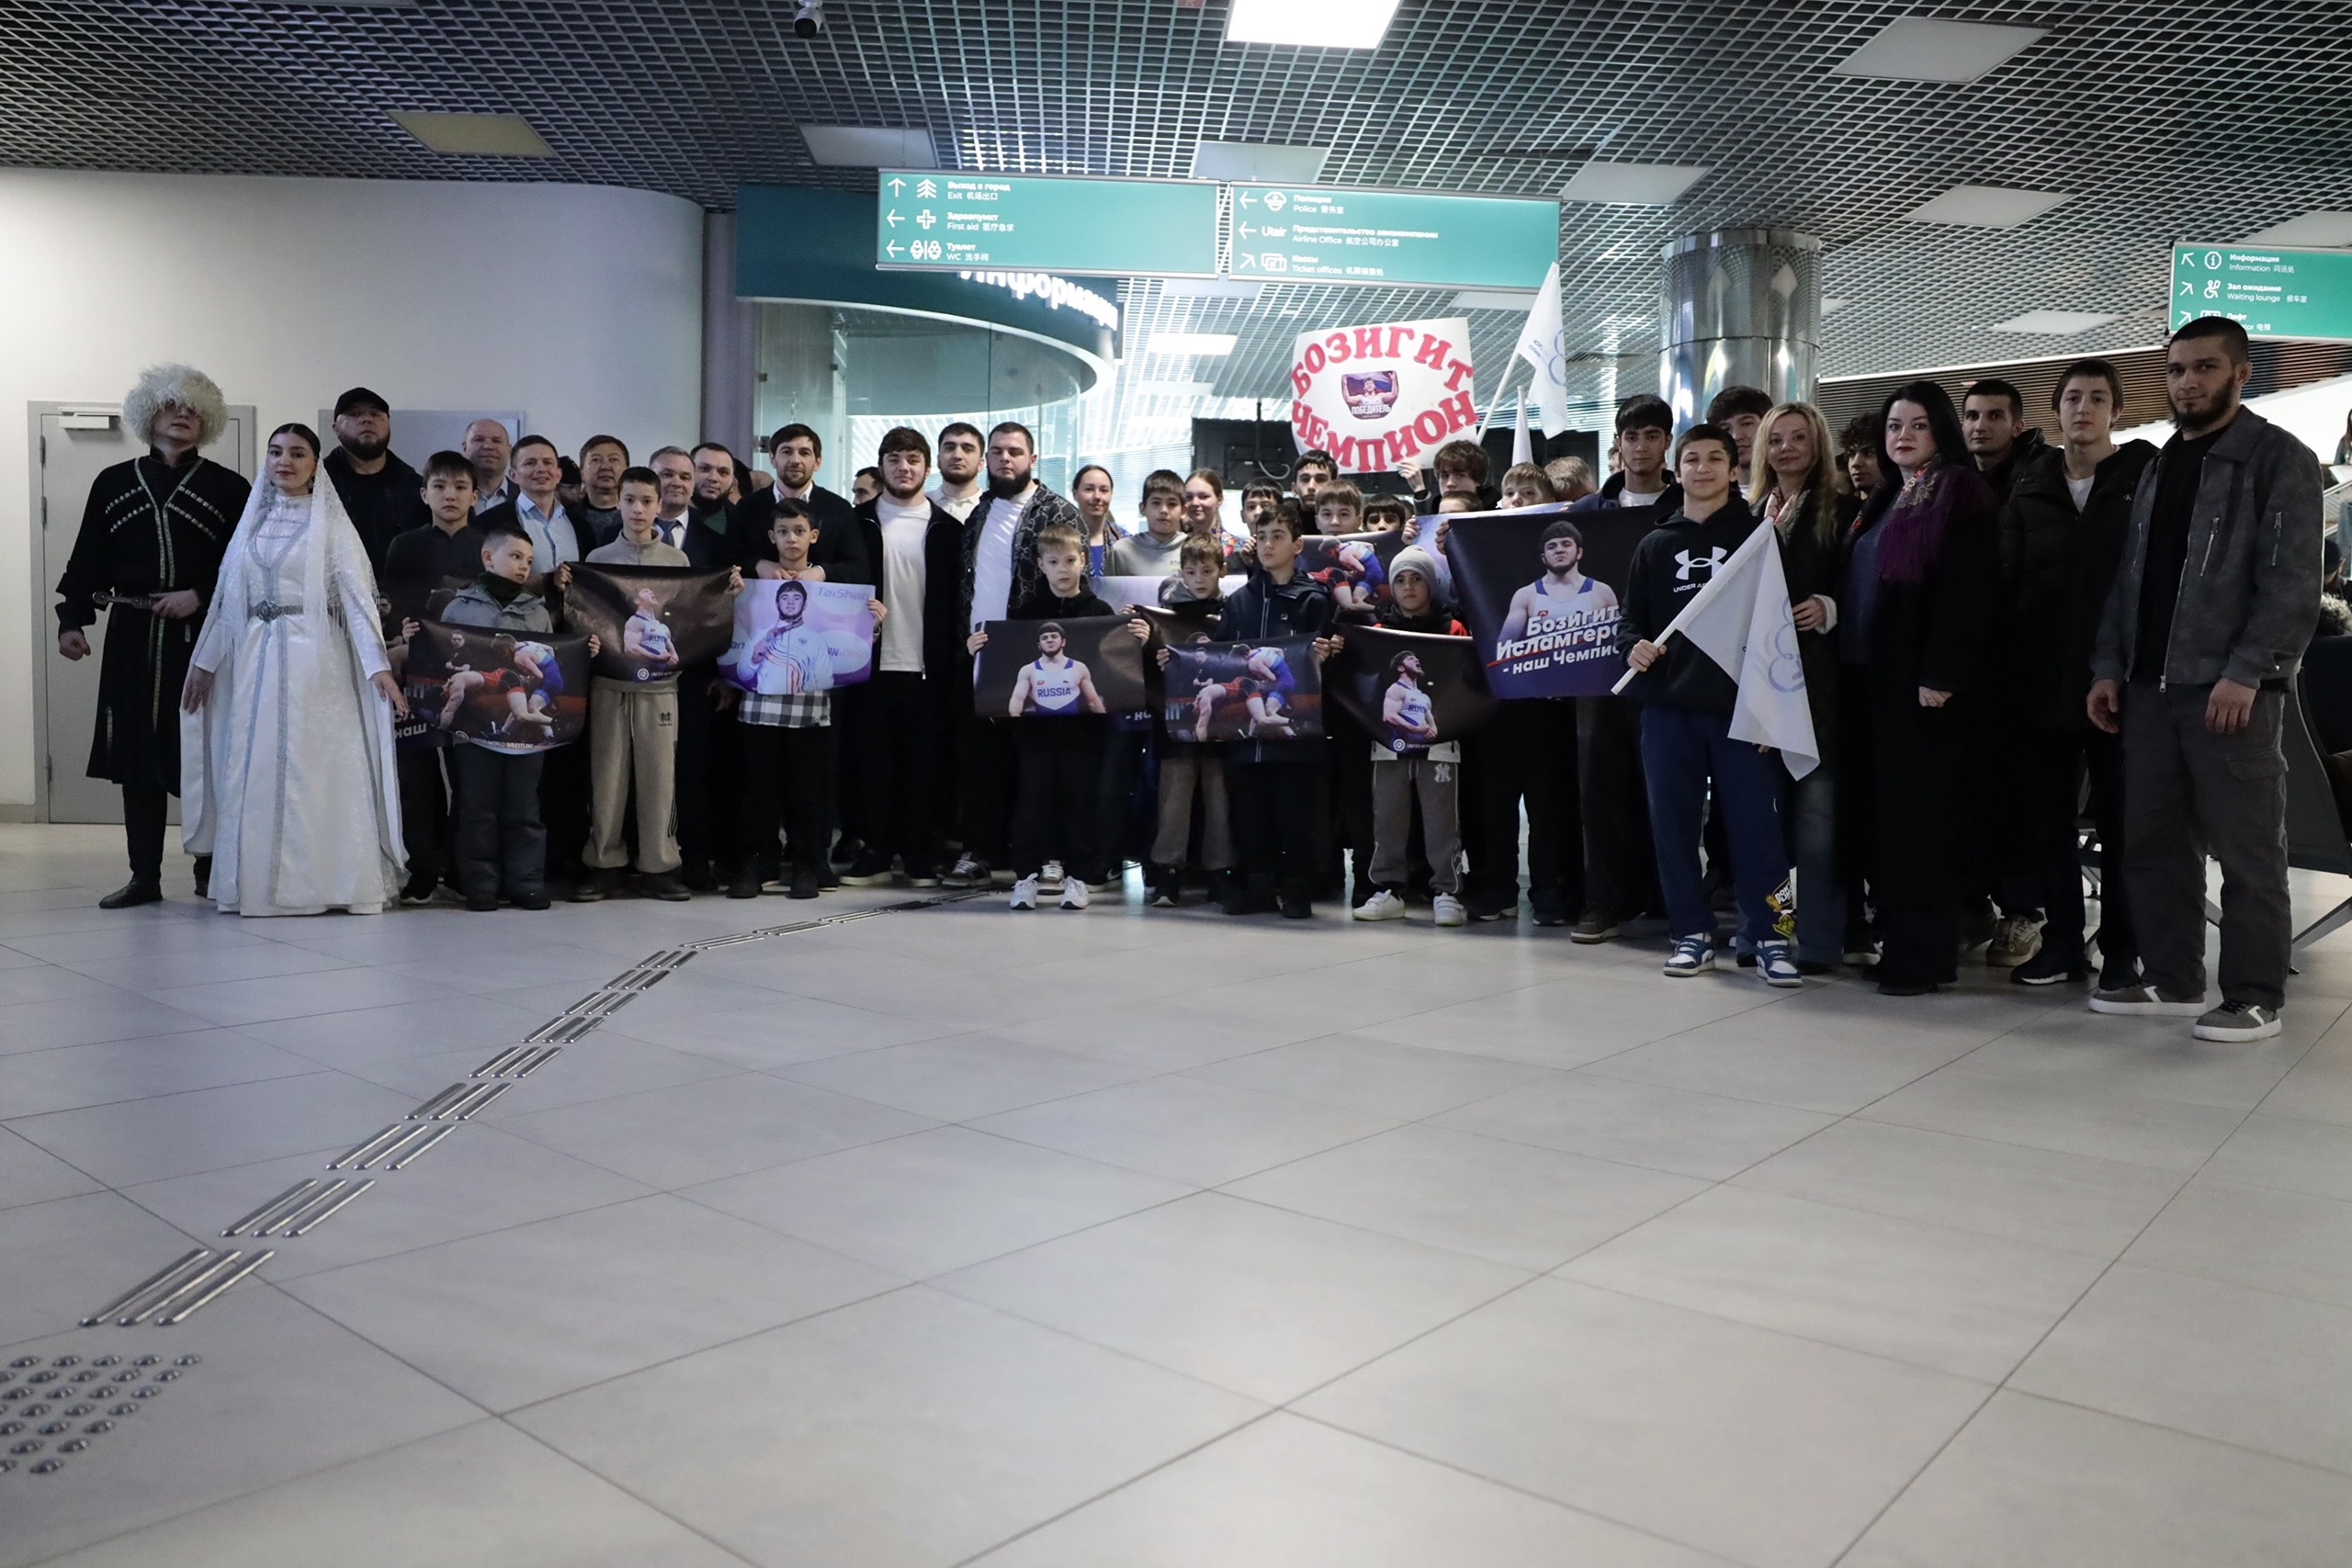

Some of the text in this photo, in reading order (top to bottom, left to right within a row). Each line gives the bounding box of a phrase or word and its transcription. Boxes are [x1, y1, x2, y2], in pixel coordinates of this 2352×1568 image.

[947, 181, 977, 190] Выход
[984, 184, 1011, 192] город
[947, 191, 963, 199] Exit
[967, 191, 998, 200] 机场出口
[1293, 194, 1332, 204] Полиция
[947, 211, 999, 222] Здравпункт
[947, 222, 965, 231] First
[1261, 226, 1286, 236] Utair
[1293, 224, 1439, 239] Представительство авиакомпании
[1318, 236, 1342, 244] Office
[1346, 237, 1399, 247] 航空公司办公室
[946, 242, 977, 252] Туалет
[946, 253, 961, 261] WC
[965, 253, 989, 262] 洗手间
[1292, 254, 1318, 263] Кассы
[2229, 254, 2279, 263] Информация
[1292, 265, 1342, 275] Ticket offices
[2229, 264, 2271, 272] Information
[2227, 282, 2282, 292] Зал ожидания
[2227, 293, 2281, 303] Waiting lounge
[2226, 312, 2247, 321] Лифт
[2256, 322, 2271, 331] 电梯
[1291, 326, 1475, 399] БОЗИГИТ
[1351, 405, 1391, 414] ПОБЕДИТЕЛЬ
[1292, 389, 1480, 472] ЧЕМПИОН
[1673, 583, 1696, 593] UNDER
[818, 587, 869, 601] TaiShan
[1526, 606, 1620, 637] Бозигит
[1512, 658, 1550, 675] наш
[1037, 687, 1072, 698] RUSSIA
[506, 741, 534, 750] WRESTLING
